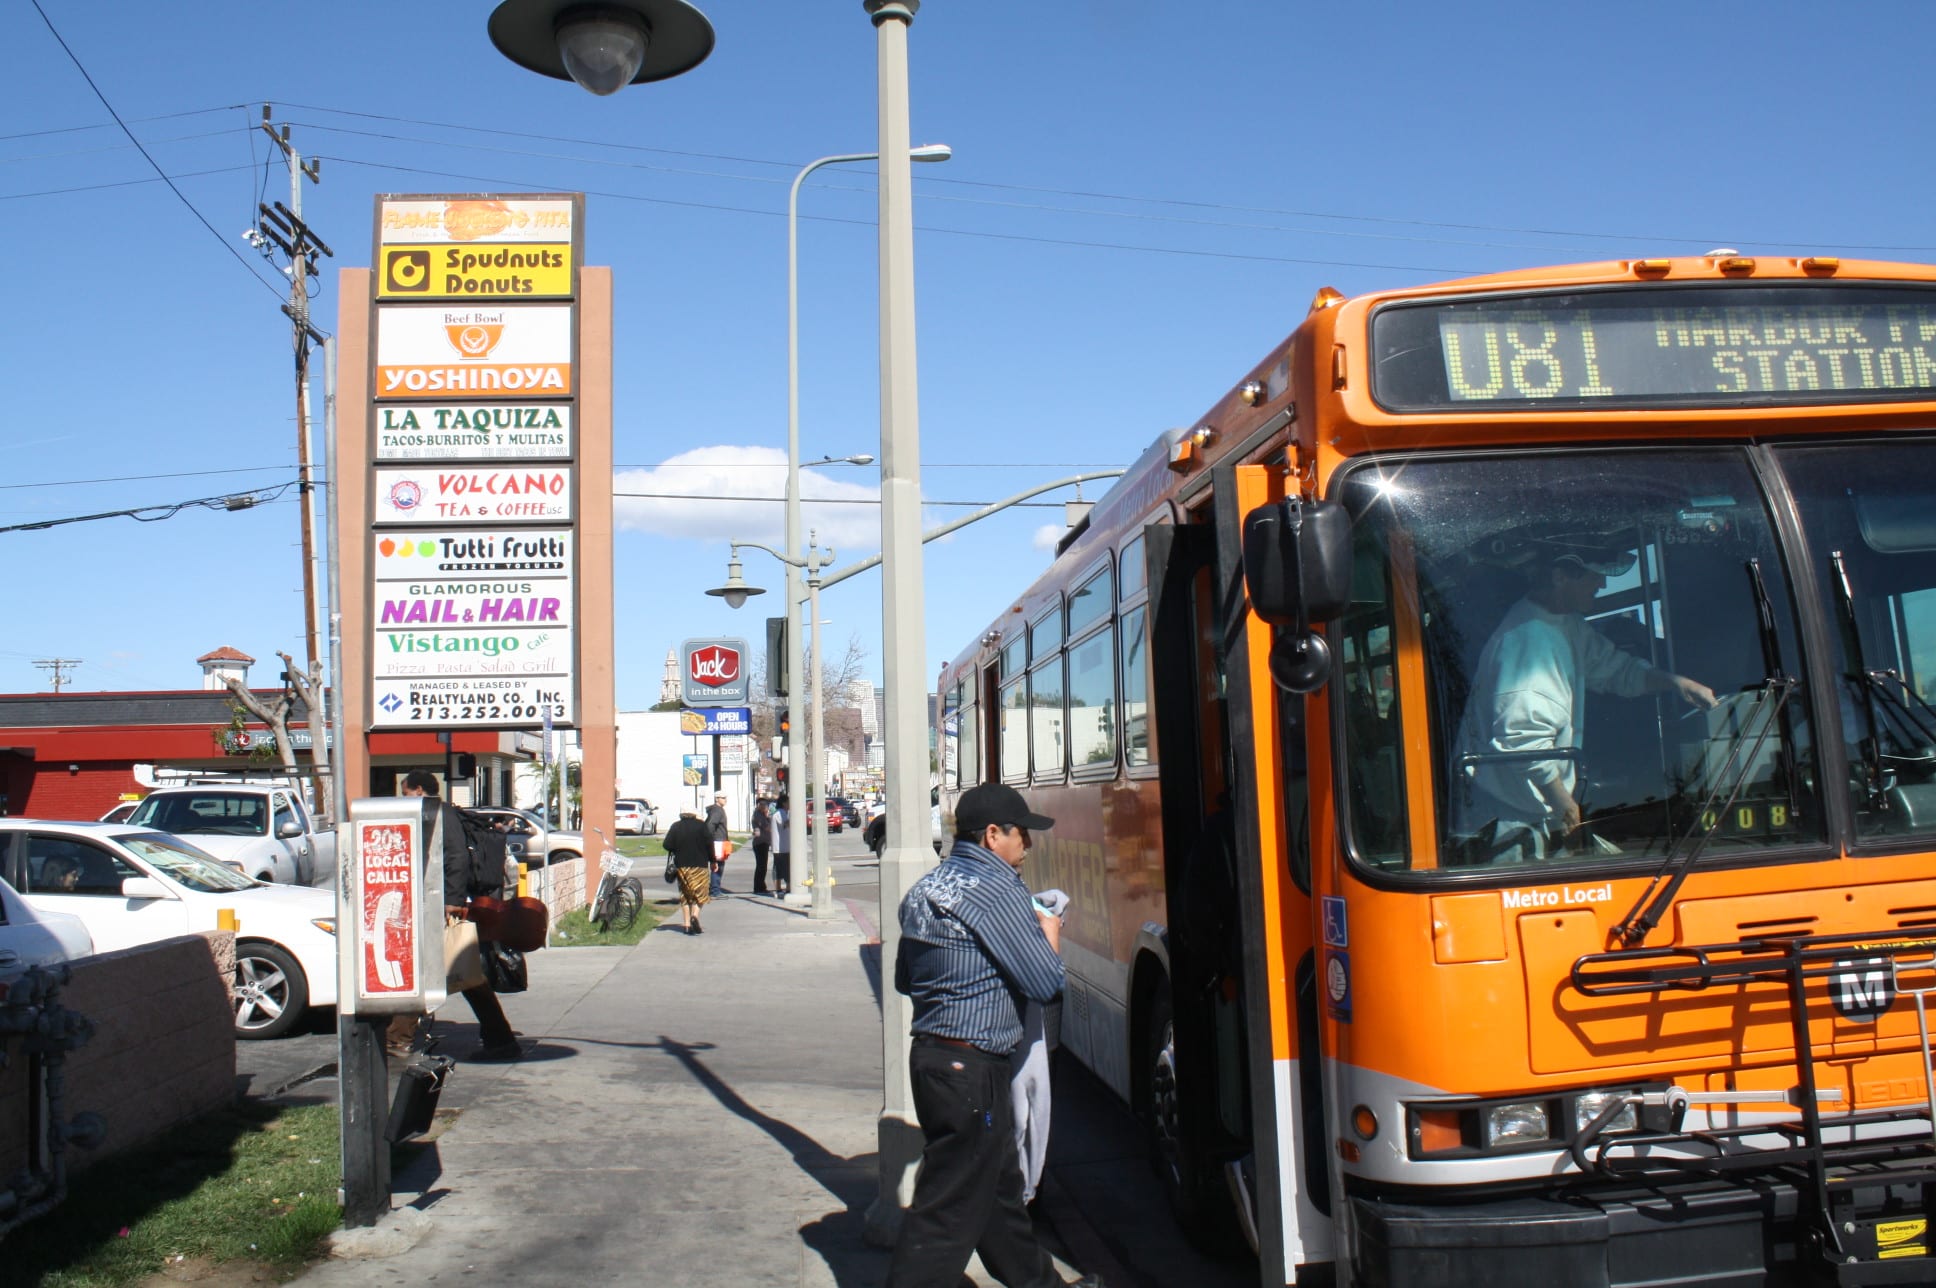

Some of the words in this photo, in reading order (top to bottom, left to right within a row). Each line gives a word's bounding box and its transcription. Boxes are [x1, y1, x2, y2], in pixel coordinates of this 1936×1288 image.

[446, 249, 563, 274] Spudnuts
[445, 274, 534, 294] Donuts
[444, 313, 470, 324] Beef
[474, 312, 504, 324] Bowl
[385, 367, 564, 391] YOSHINOYA
[383, 409, 420, 430] LA
[434, 408, 562, 434] TAQUIZA
[383, 434, 490, 446] TACOS-BURRITOS
[496, 434, 503, 445] Y
[509, 433, 564, 445] MULITAS
[438, 473, 564, 496] VOLCANO
[435, 502, 471, 517] TEA
[477, 507, 488, 516] &
[496, 502, 546, 516] COFFEE
[439, 536, 494, 559] Tutti
[443, 563, 496, 571] FROZEN
[506, 562, 560, 570] YOGURT
[409, 583, 532, 595] GLAMOROUS
[381, 600, 459, 624] NAIL
[462, 608, 474, 623] &
[479, 598, 561, 622] HAIR
[388, 633, 520, 657] Vistango
[387, 662, 426, 674] Pizza
[437, 662, 472, 674] Pasta
[480, 660, 515, 673] Salad
[523, 657, 556, 673] Grill
[692, 649, 738, 679] Jack
[410, 682, 459, 690] MANAGED
[473, 681, 511, 689] LEASED
[691, 687, 701, 696] in
[702, 687, 719, 695] the
[721, 687, 741, 695] box
[410, 705, 565, 720] 213.252.003
[716, 711, 739, 722] OPEN
[708, 722, 719, 731] 24
[720, 721, 748, 731] HOURS
[365, 855, 409, 867] LOCAL
[366, 870, 409, 884] CALLS
[1502, 889, 1559, 909] Metro
[1563, 883, 1612, 904] Local
